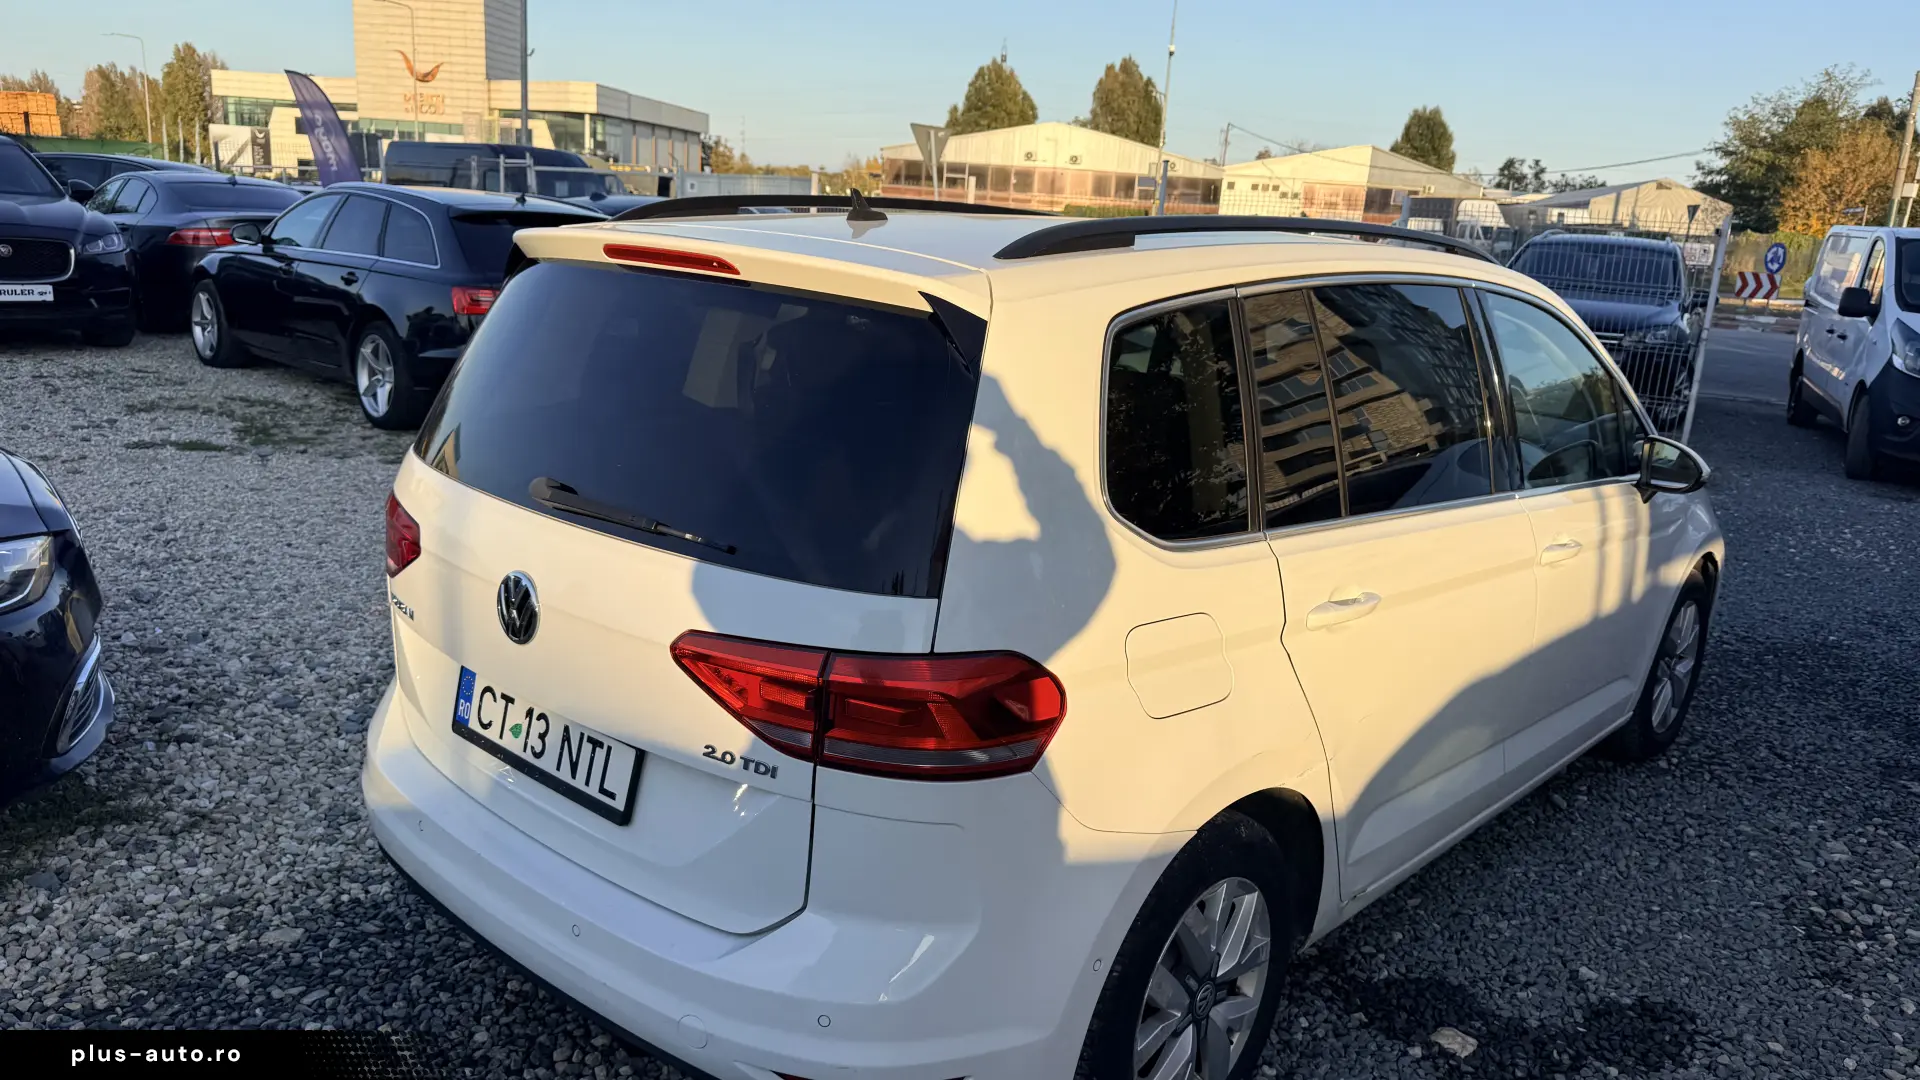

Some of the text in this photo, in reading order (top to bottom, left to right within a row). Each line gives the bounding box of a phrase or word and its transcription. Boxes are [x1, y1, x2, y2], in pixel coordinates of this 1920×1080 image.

[458, 698, 471, 719] RO
[477, 685, 618, 802] CT 13 NTL
[702, 744, 779, 780] 2.0 TDI
